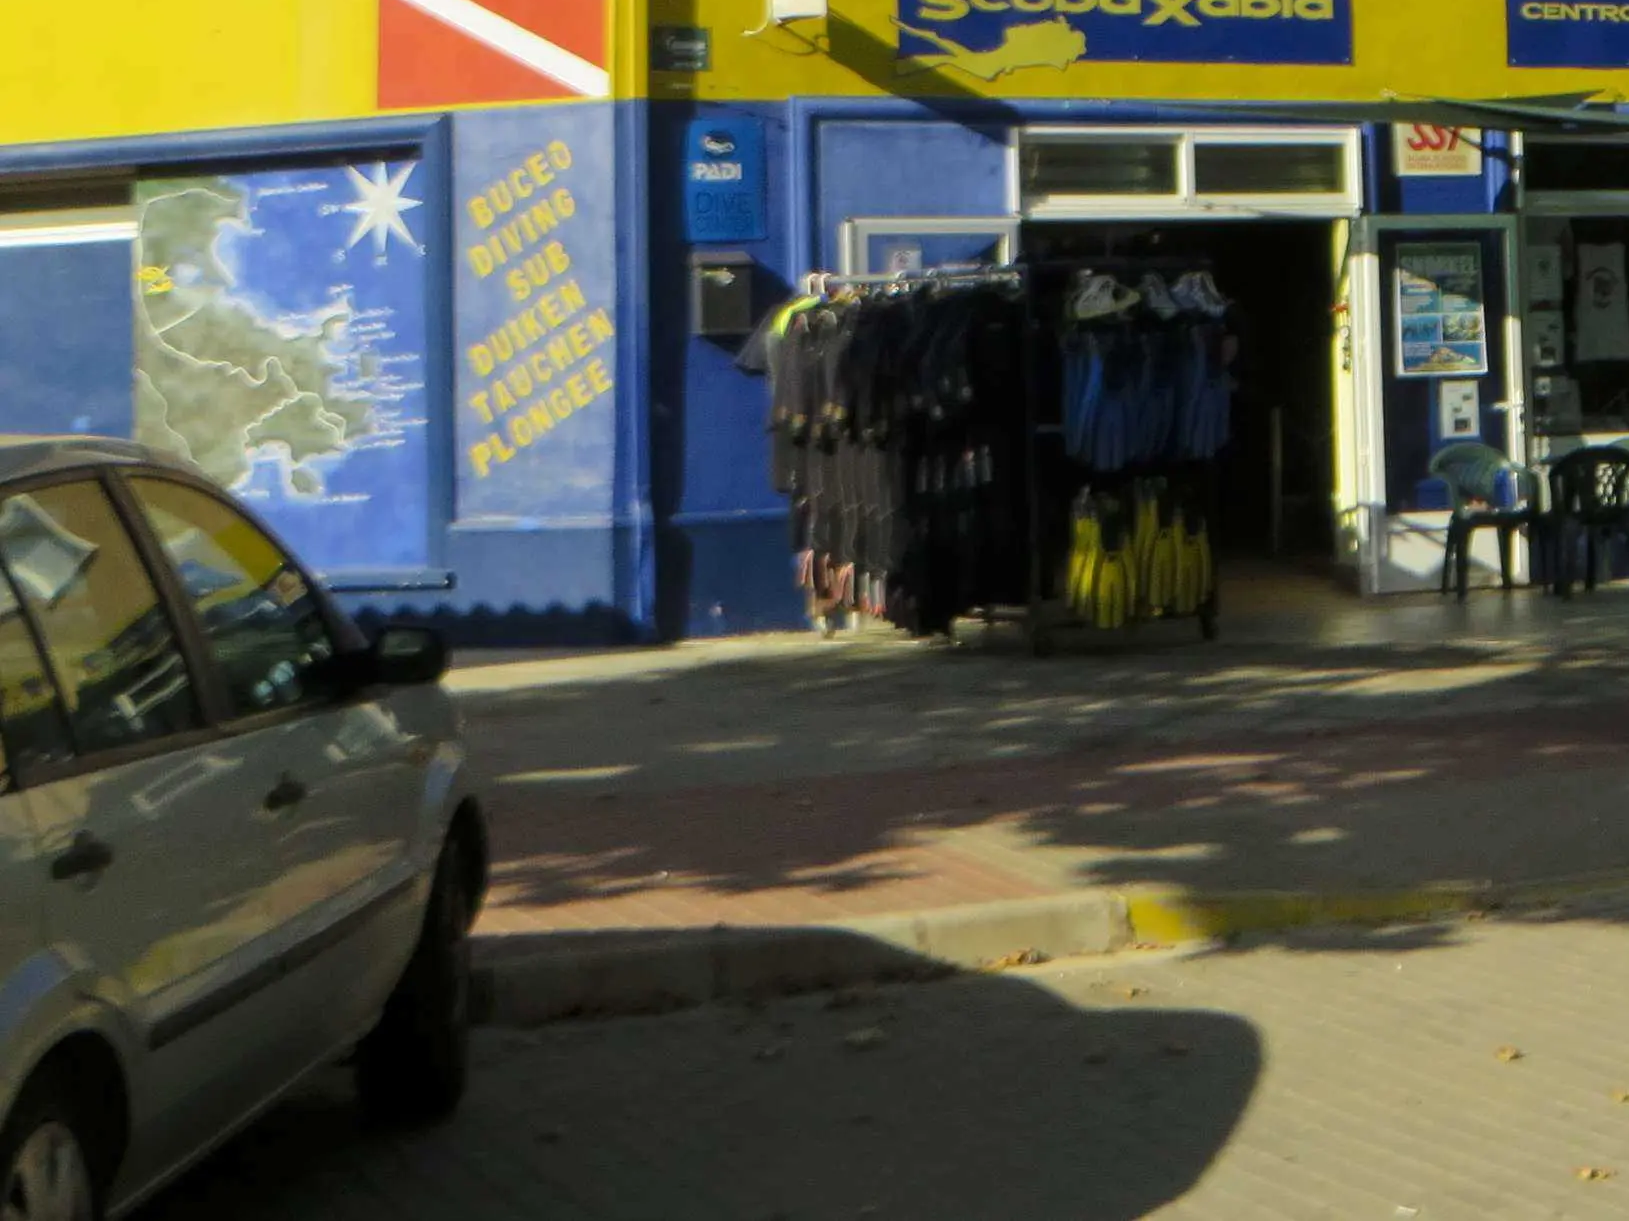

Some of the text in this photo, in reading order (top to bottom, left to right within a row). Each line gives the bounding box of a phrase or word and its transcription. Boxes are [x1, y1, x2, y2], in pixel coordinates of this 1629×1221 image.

[467, 139, 573, 230] BUCEO
[691, 161, 743, 181] PADI
[467, 188, 576, 278] DIVING
[505, 239, 571, 302] SUB
[466, 279, 587, 377] DUIKEN
[468, 307, 615, 425] TAUCHEN
[467, 358, 614, 478] PLONGEE
